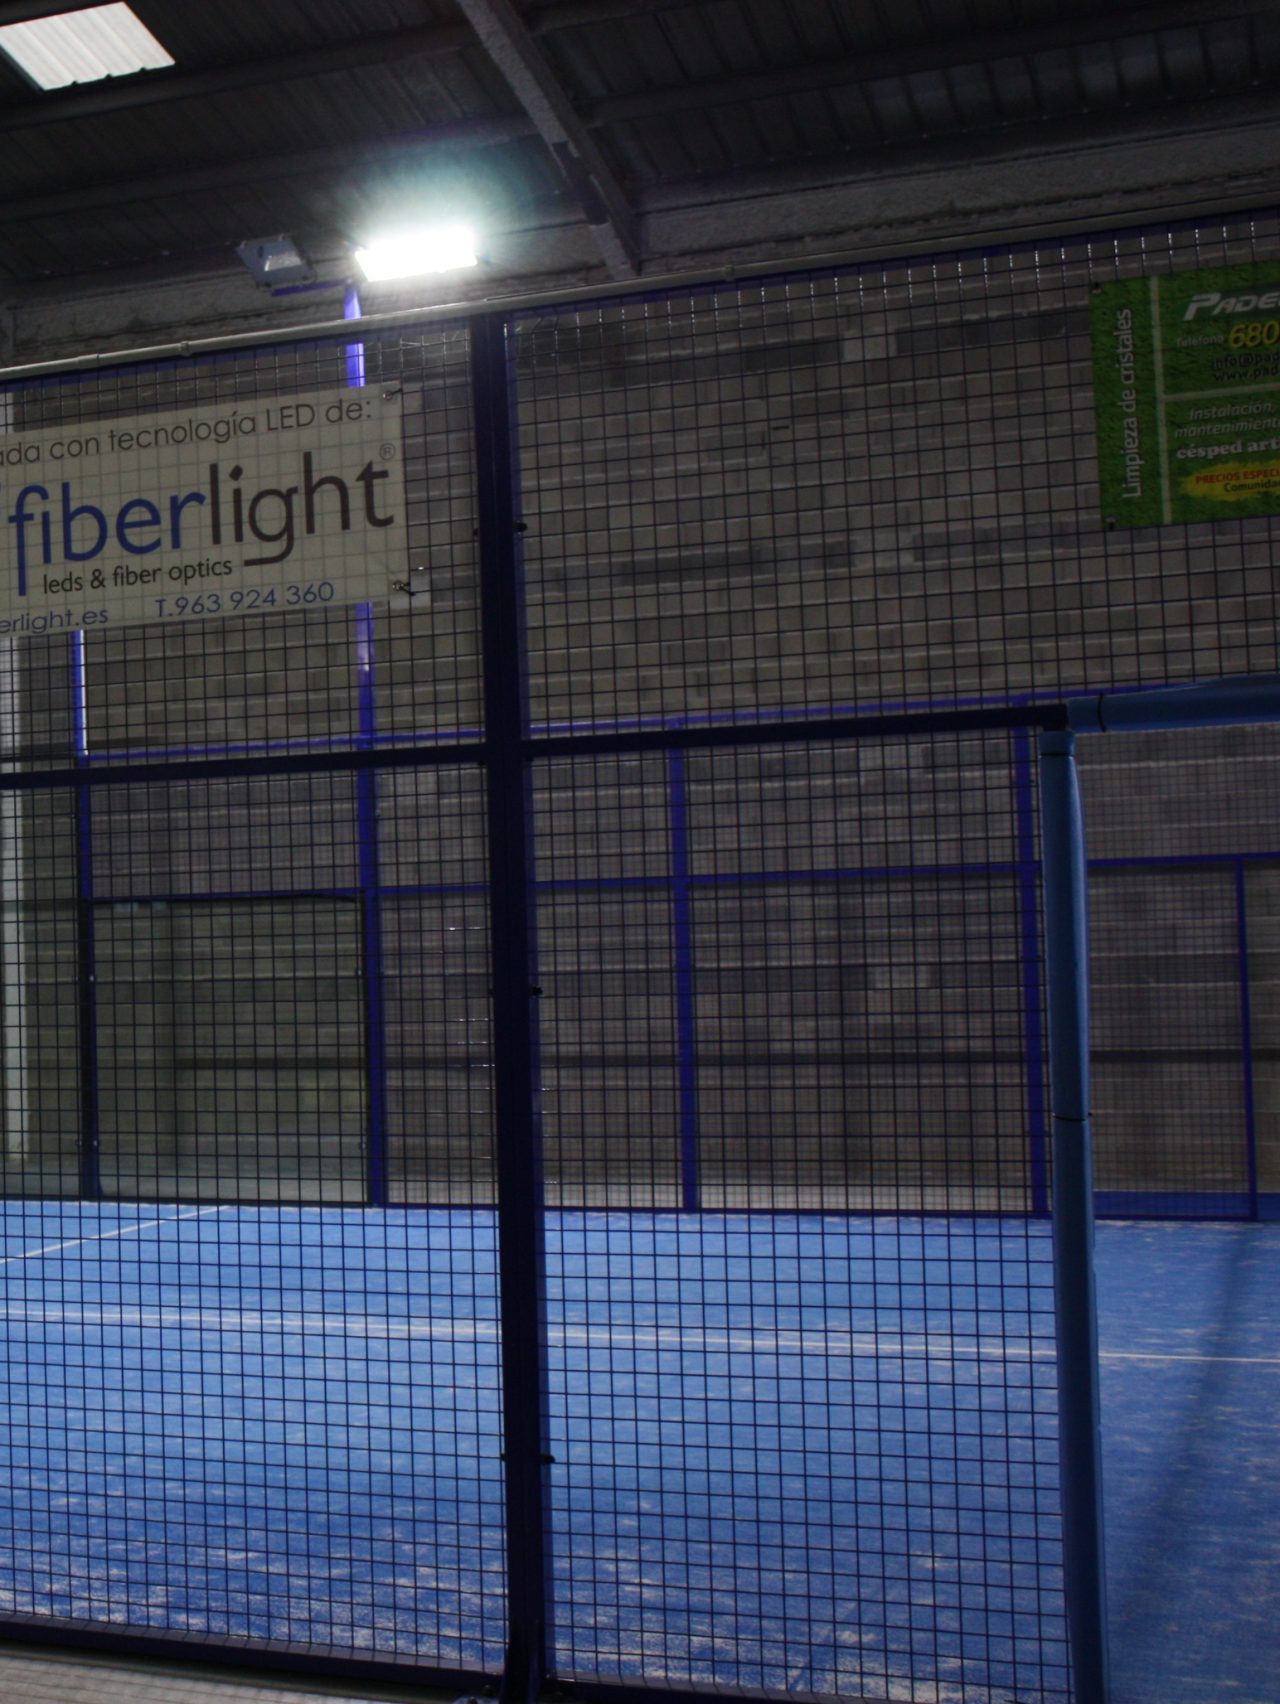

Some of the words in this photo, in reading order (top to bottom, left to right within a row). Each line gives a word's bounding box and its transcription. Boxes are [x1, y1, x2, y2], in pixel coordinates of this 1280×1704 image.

[1183, 292, 1280, 321] PADE
[1113, 308, 1135, 385] cristales
[1229, 320, 1280, 349] 680
[1117, 388, 1136, 413] de
[49, 433, 100, 461] con
[108, 411, 257, 452] tecnología
[266, 402, 316, 432] LED
[325, 399, 372, 424] de:
[1176, 440, 1243, 460] césped
[1247, 436, 1280, 453] art
[1122, 416, 1146, 498] Limpieza
[1195, 471, 1240, 485] PRECIOS
[8, 451, 395, 598] fiberlight
[43, 571, 84, 595] leds
[90, 568, 106, 590] &
[112, 565, 162, 588] fiber
[168, 558, 233, 585] optics
[154, 593, 221, 618] T.963
[229, 587, 277, 611] 924
[285, 581, 334, 606] 360
